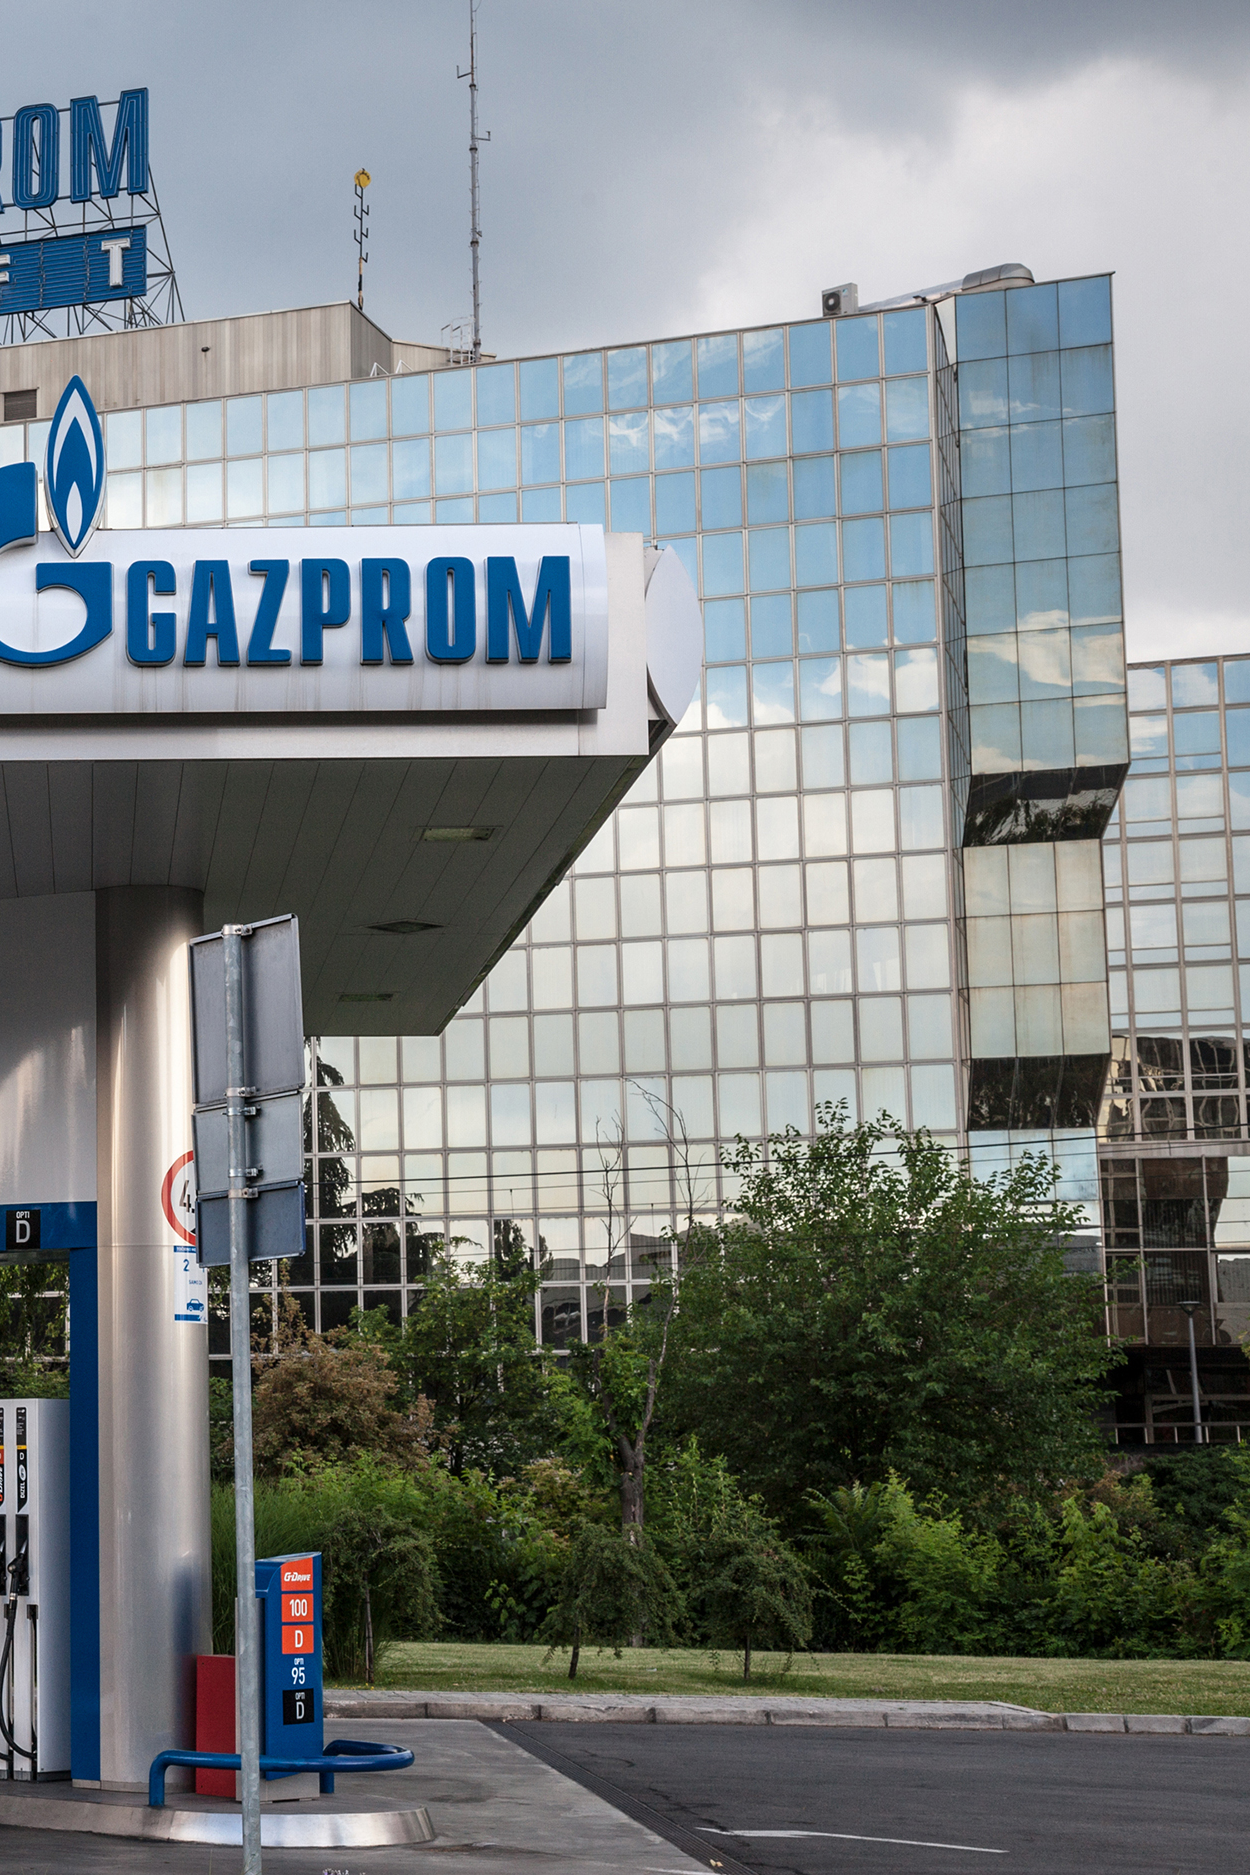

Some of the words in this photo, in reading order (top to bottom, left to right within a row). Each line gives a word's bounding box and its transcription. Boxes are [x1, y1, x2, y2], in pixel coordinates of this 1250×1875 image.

[125, 555, 573, 667] GAZPROM
[179, 1179, 196, 1213] 4.
[15, 1211, 30, 1219] OPTI
[15, 1219, 31, 1244] D
[183, 1258, 190, 1272] 2
[19, 1452, 25, 1460] D
[289, 1599, 308, 1617] 100
[294, 1630, 304, 1648] D
[291, 1667, 306, 1685] 95
[295, 1701, 305, 1720] D
